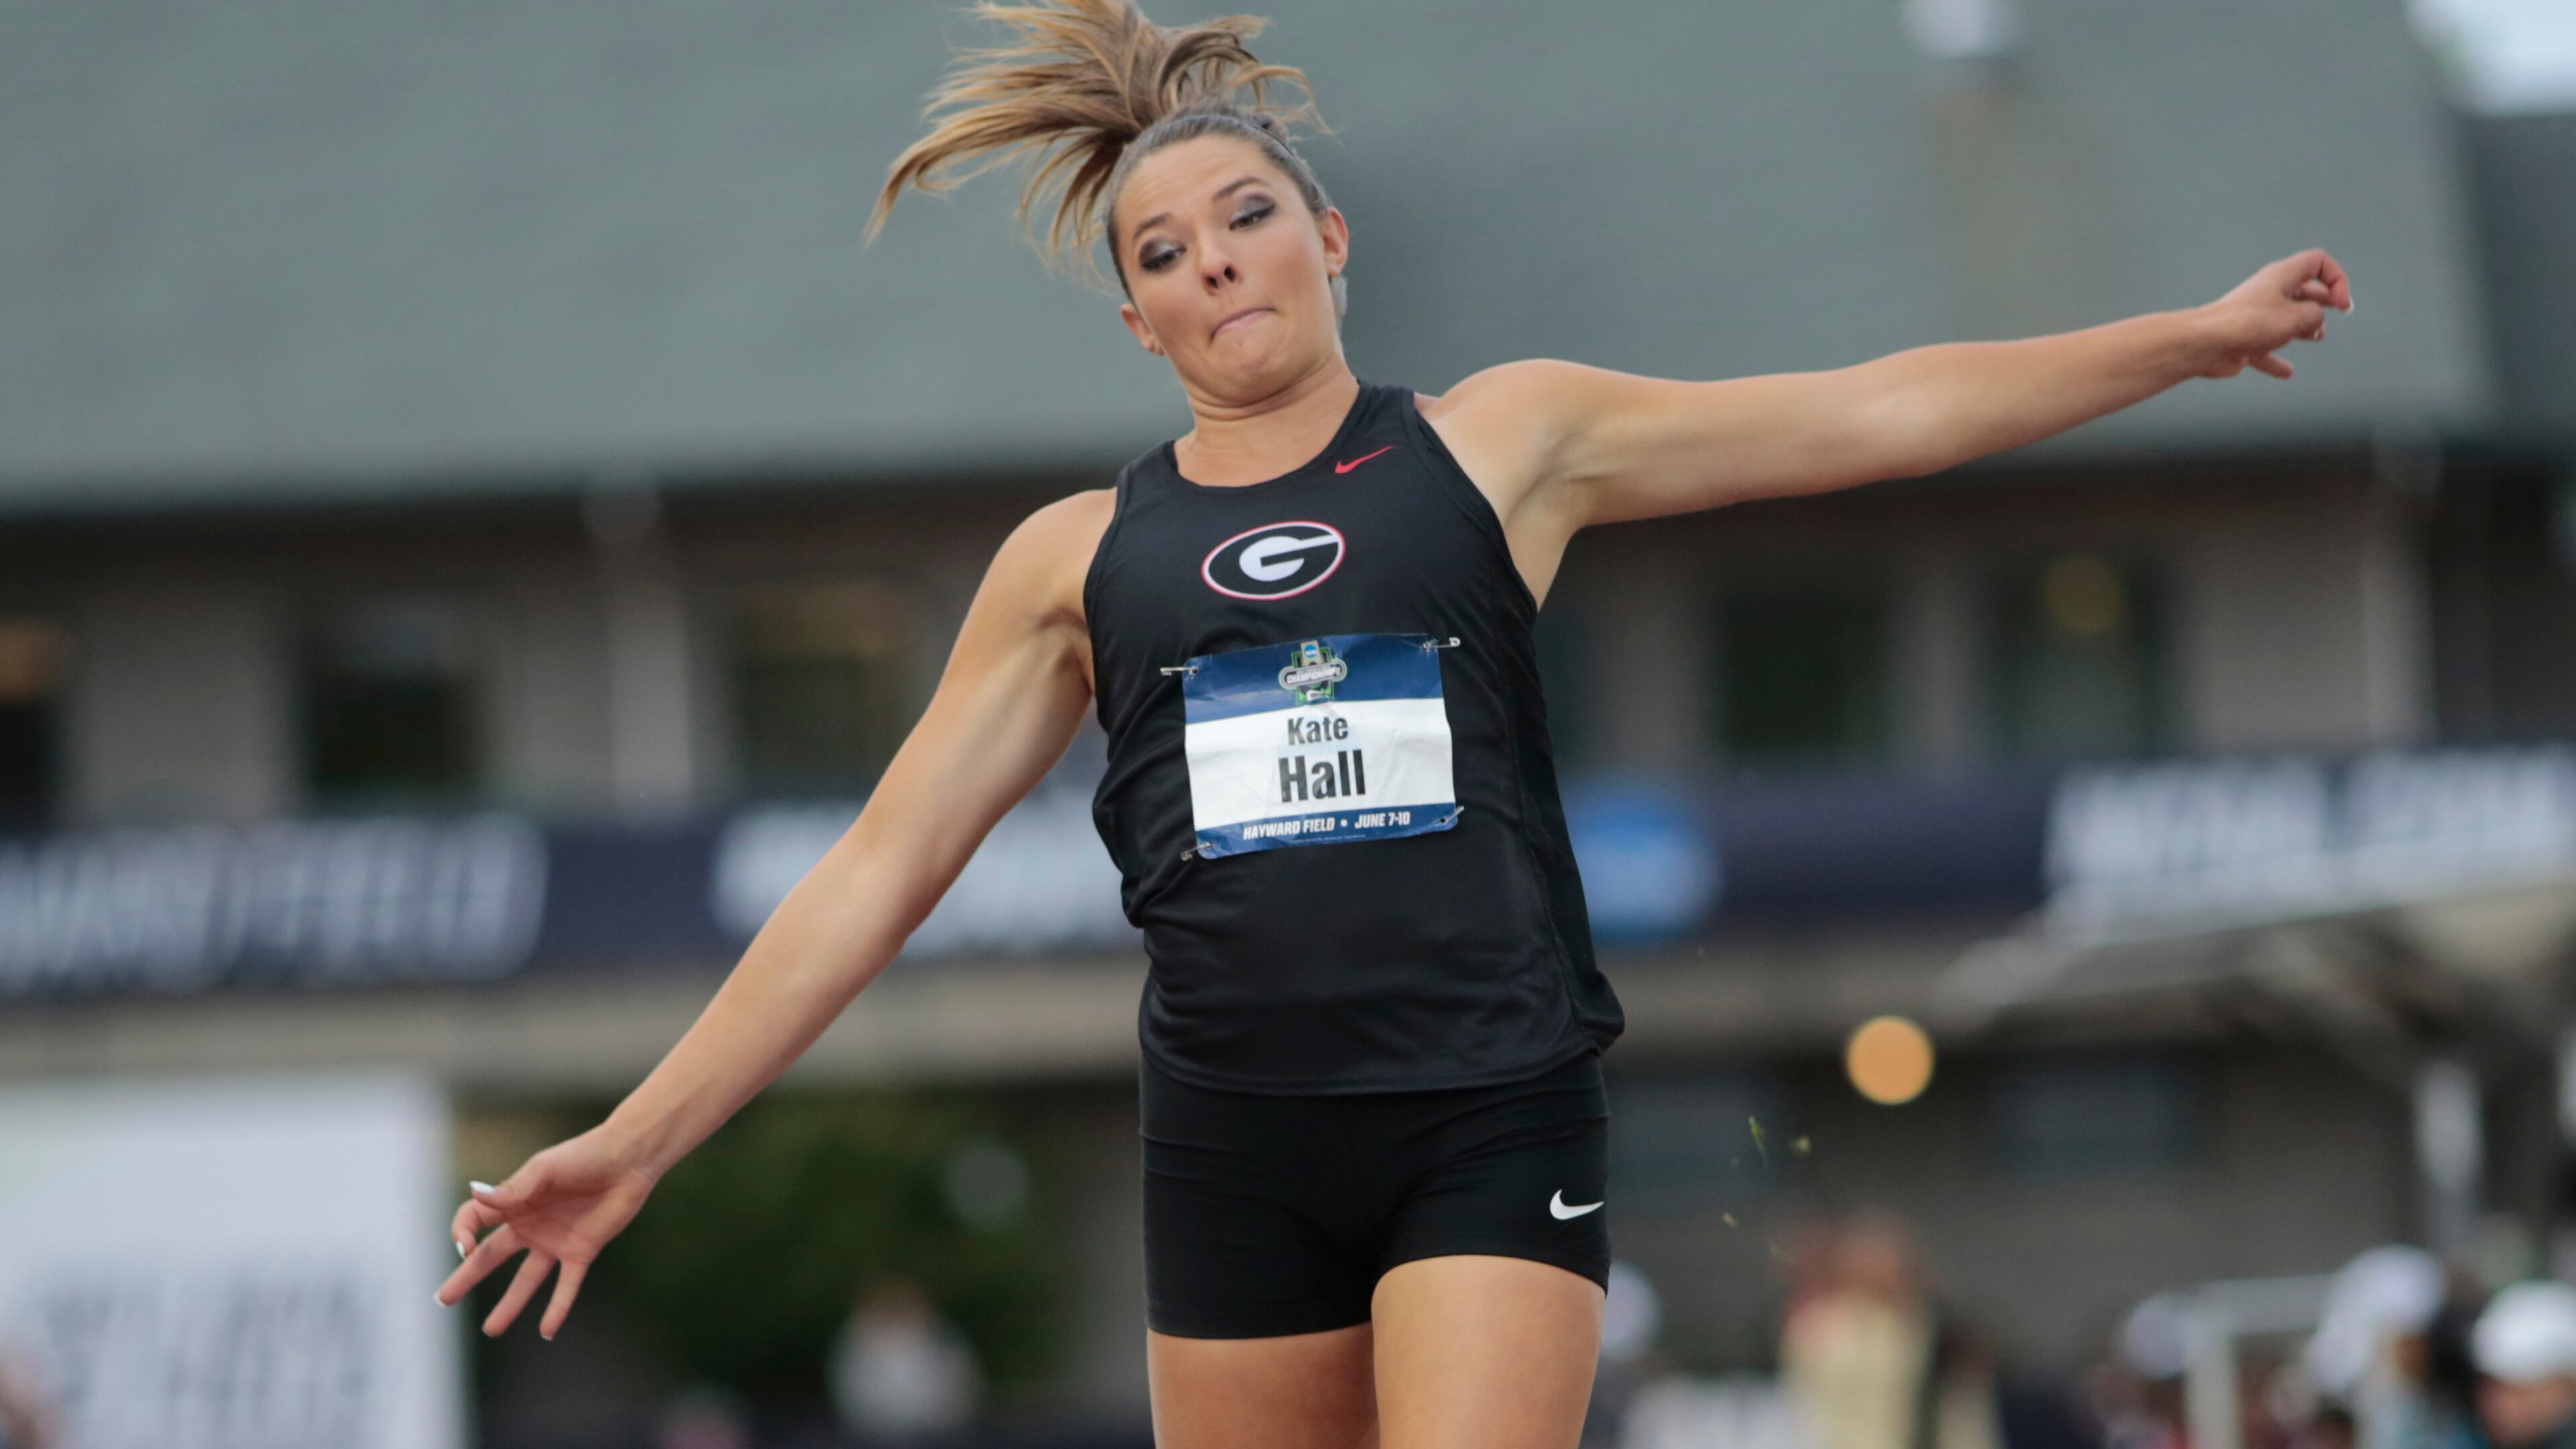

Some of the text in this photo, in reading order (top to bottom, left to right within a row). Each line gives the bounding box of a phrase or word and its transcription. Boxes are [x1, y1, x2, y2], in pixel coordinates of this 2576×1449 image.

[1239, 535, 1339, 582] G
[1287, 716, 1348, 746] Kate
[1278, 749, 1366, 803] Hall
[1243, 822, 1301, 840] HAYWARD
[1303, 817, 1335, 833] FIELD
[1354, 812, 1386, 828] JUNE
[1388, 811, 1411, 826] 7-10
